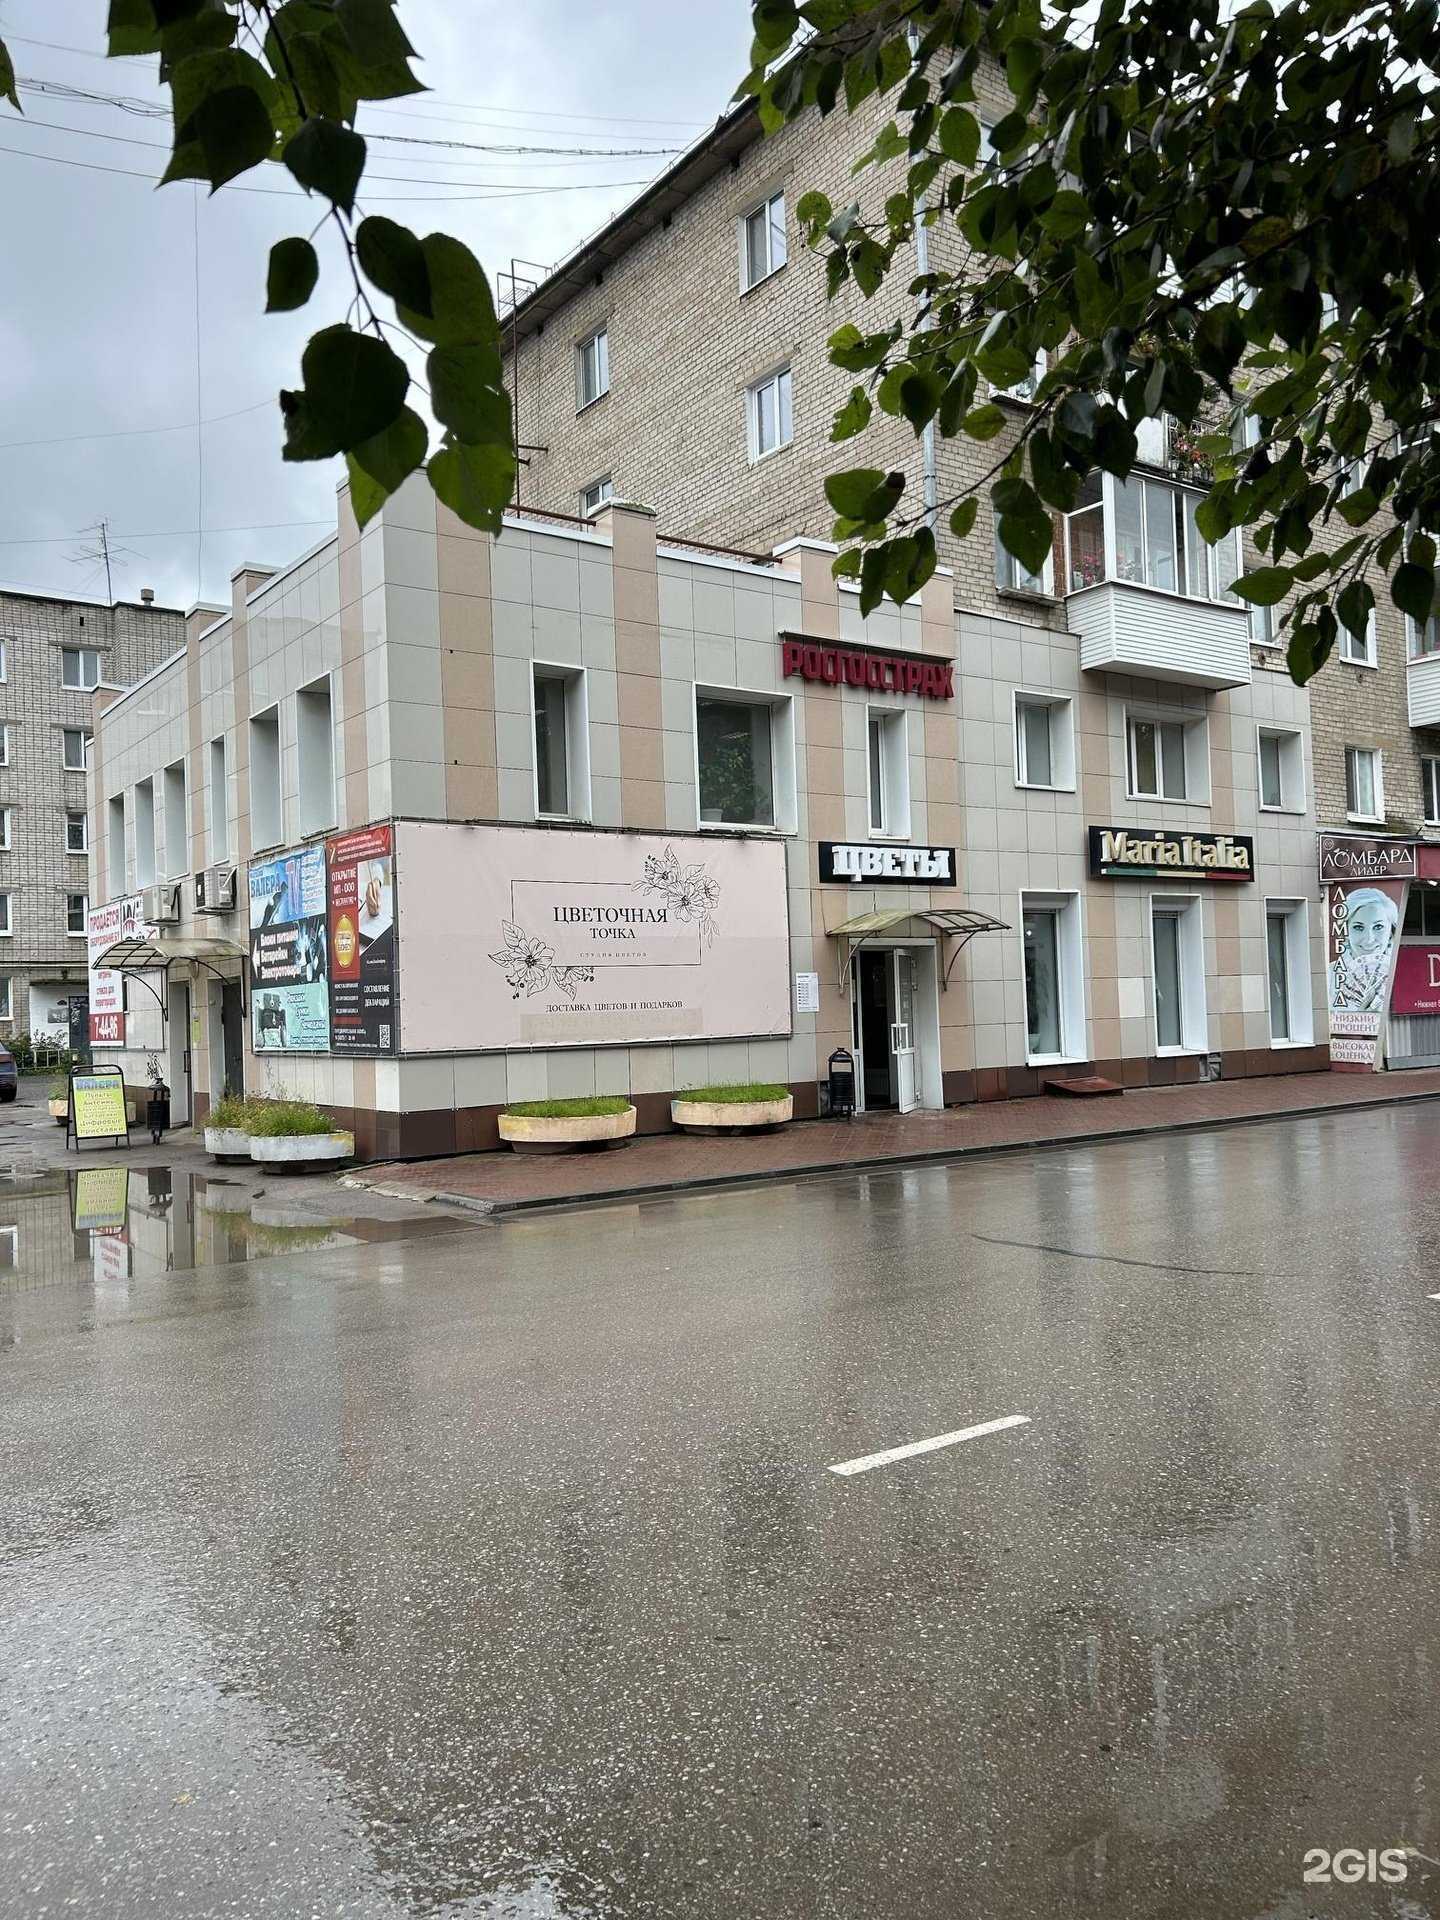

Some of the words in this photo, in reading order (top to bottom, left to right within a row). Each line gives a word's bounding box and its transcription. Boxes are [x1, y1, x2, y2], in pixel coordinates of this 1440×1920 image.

[783, 641, 953, 698] РОСГОССТРАХ
[1100, 830, 1181, 865] Maria
[1181, 836, 1249, 869] Italia
[832, 845, 950, 882] ЦВЕТЫ
[1323, 848, 1412, 867] ЛОМБАРД
[1350, 865, 1387, 876] ЛИДЕР
[250, 873, 281, 897] ВАЛЕРА
[553, 906, 668, 924] ЦВЕТОЧНАЯ
[590, 928, 636, 939] ТОЧКА
[1332, 886, 1349, 1007] ЛОМБАРД
[546, 1003, 591, 1013] ДОСТАВКА
[594, 1002, 627, 1011] ЦВЕТОВ
[630, 1002, 637, 1010] И
[640, 1001, 683, 1010] ПОДАРКОВ
[1335, 1014, 1375, 1023] НИЗКИЙ
[1333, 1023, 1376, 1032] ПРОЦЕНТ
[1332, 1042, 1375, 1051] ВЫСОКАЯ
[1335, 1051, 1371, 1060] ОЦЕНКА
